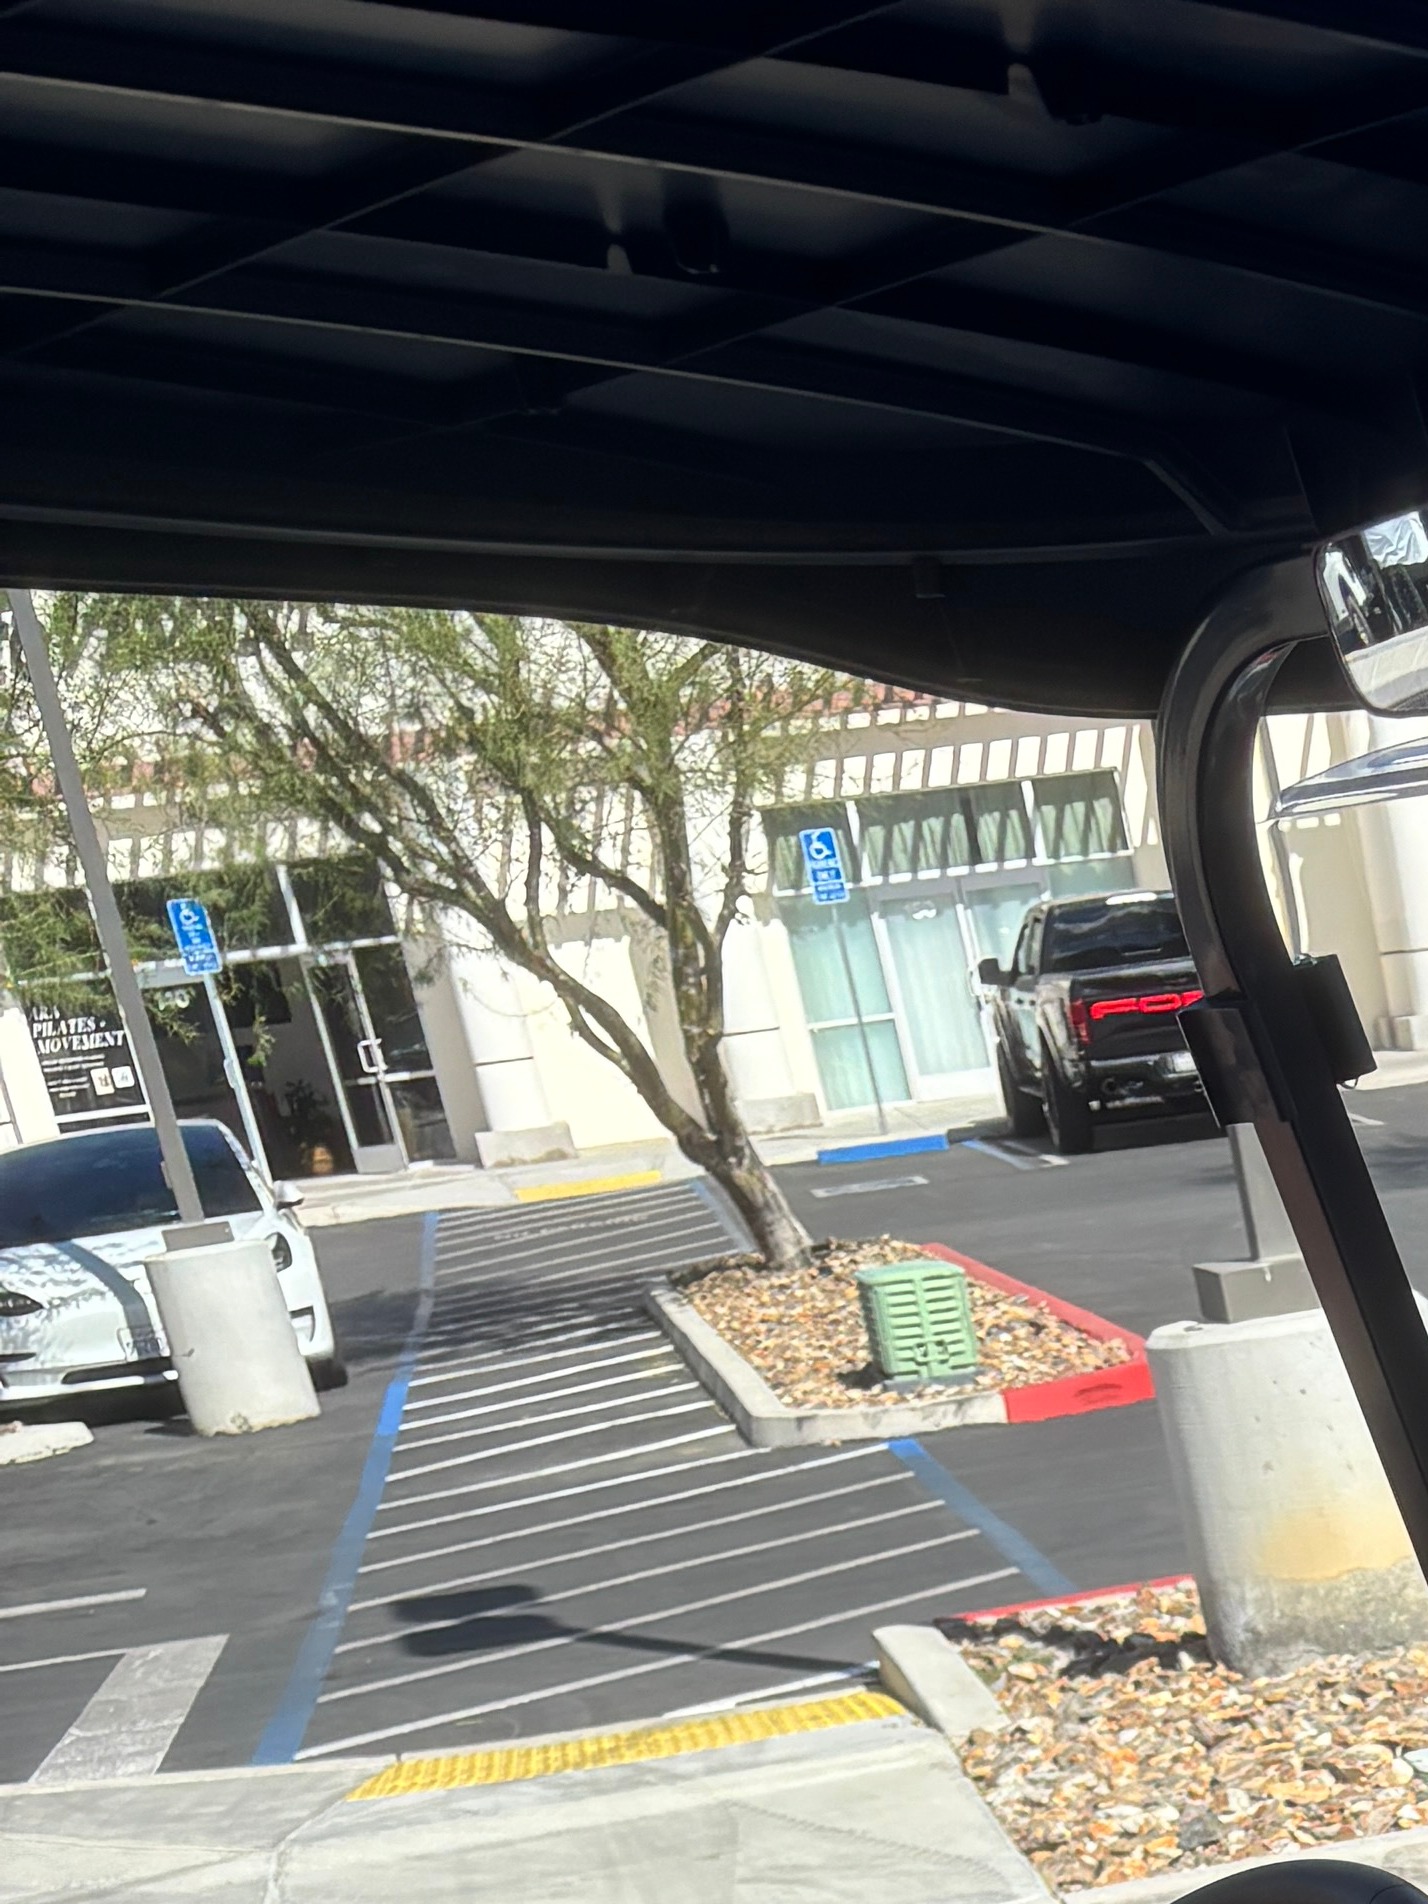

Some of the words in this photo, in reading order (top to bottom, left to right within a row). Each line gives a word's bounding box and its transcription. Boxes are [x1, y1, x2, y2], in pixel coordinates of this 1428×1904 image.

[1089, 989, 1204, 1020] FO
[33, 1016, 96, 1038] PILATES
[37, 1030, 125, 1055] MOVEMENT
